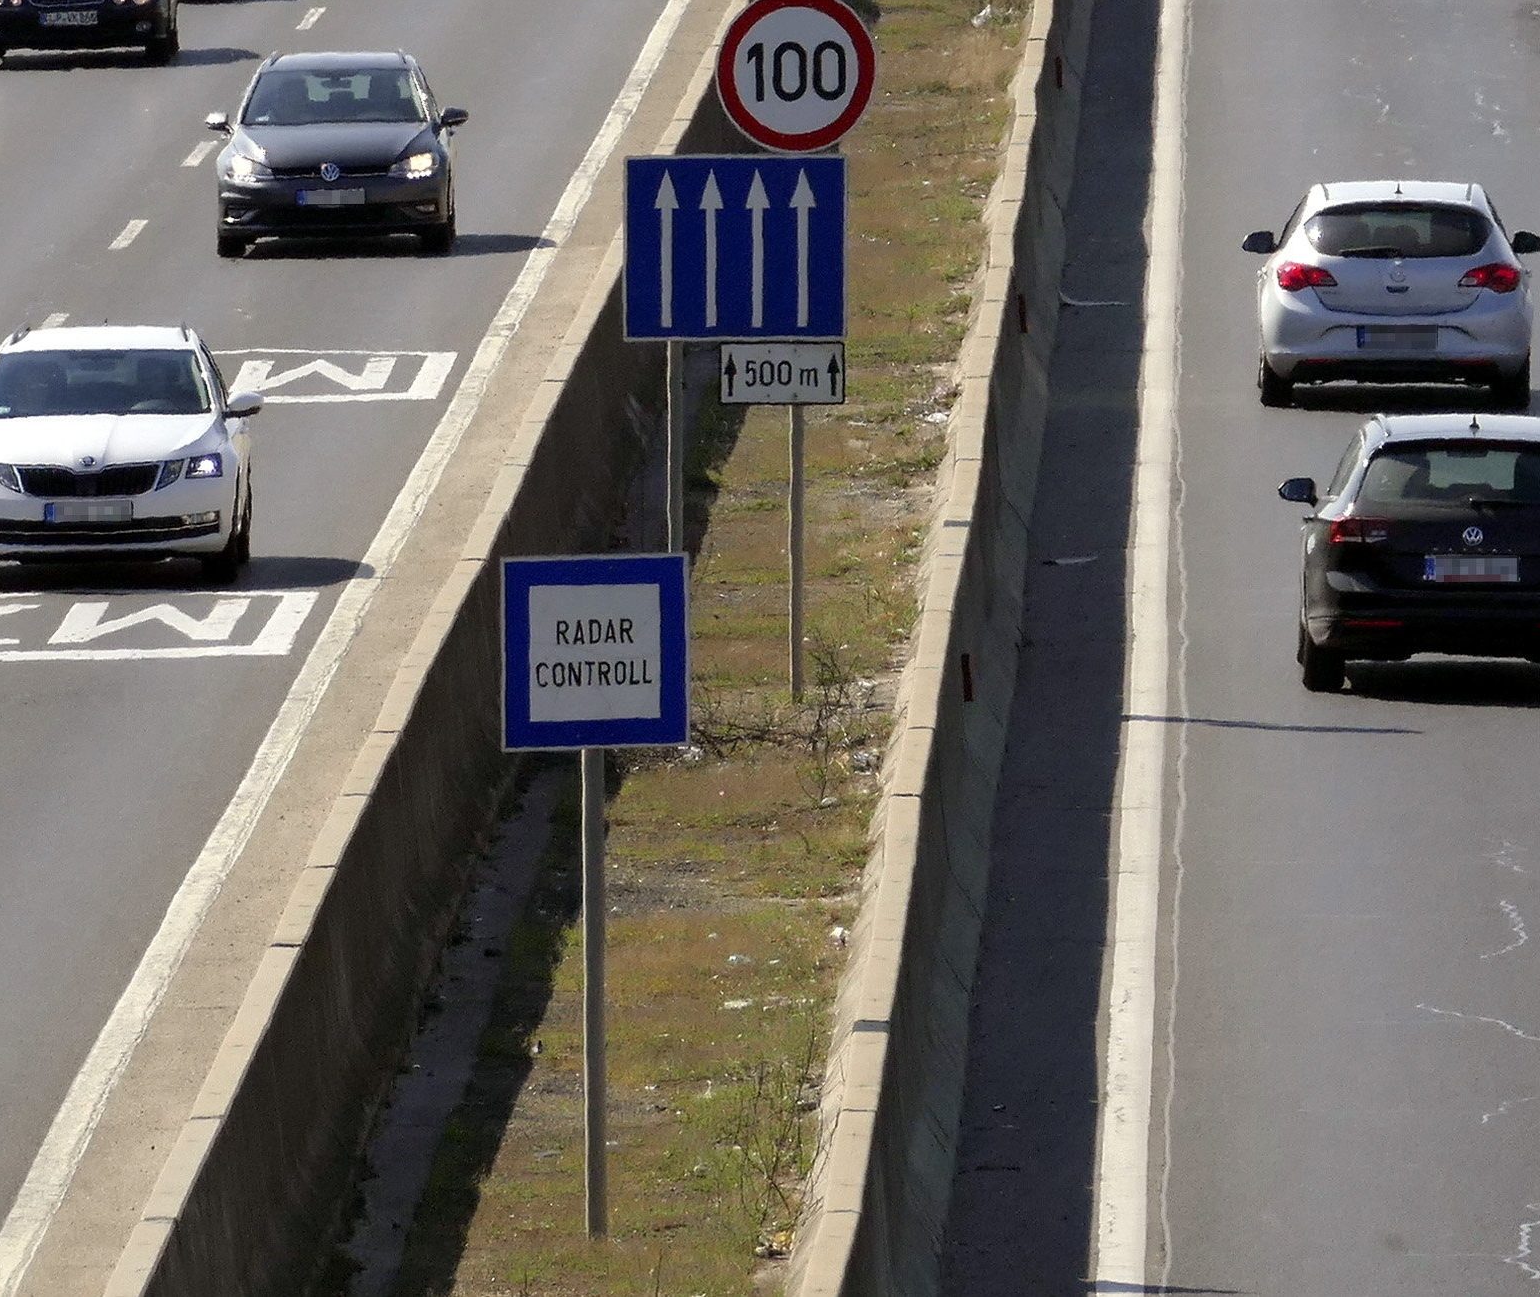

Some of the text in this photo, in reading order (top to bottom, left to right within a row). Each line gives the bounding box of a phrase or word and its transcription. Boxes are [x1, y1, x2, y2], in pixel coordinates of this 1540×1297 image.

[747, 40, 846, 102] 100
[745, 360, 818, 388] 500 m
[556, 618, 634, 645] RADAR
[535, 659, 653, 688] CONTROLL
